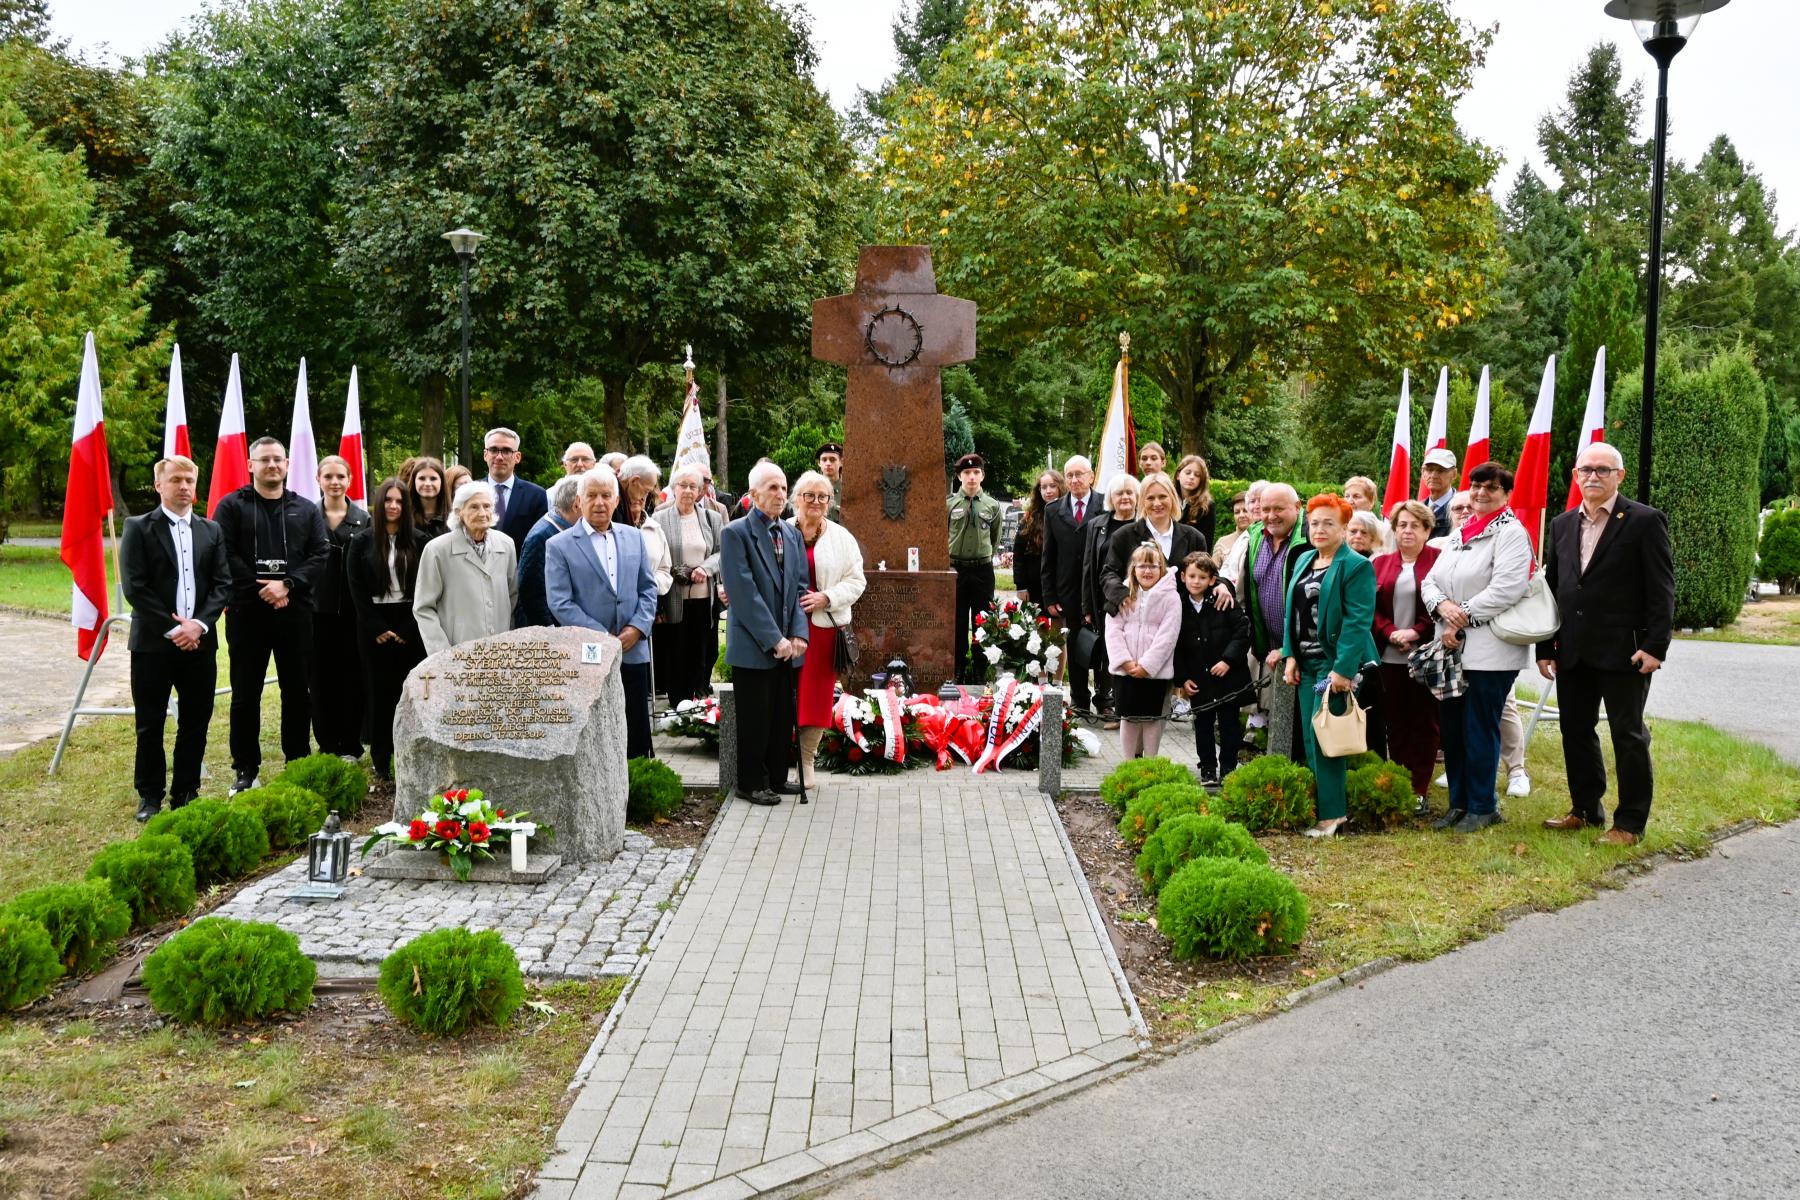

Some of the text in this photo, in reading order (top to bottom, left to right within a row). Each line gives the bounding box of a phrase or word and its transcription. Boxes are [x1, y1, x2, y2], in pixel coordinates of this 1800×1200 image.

[474, 642, 550, 651] W HOŁDZIE
[453, 650, 571, 660] MATKOM POLKOM
[464, 660, 561, 670] SYBIRACZKOM
[515, 679, 533, 687] DO
[536, 678, 568, 686] BOGA
[454, 694, 465, 702] W
[468, 693, 508, 702] LATACH
[480, 700, 493, 709] NA
[506, 707, 522, 716] DO
[531, 707, 569, 716] POLSKI
[491, 723, 529, 732] DZIECI
